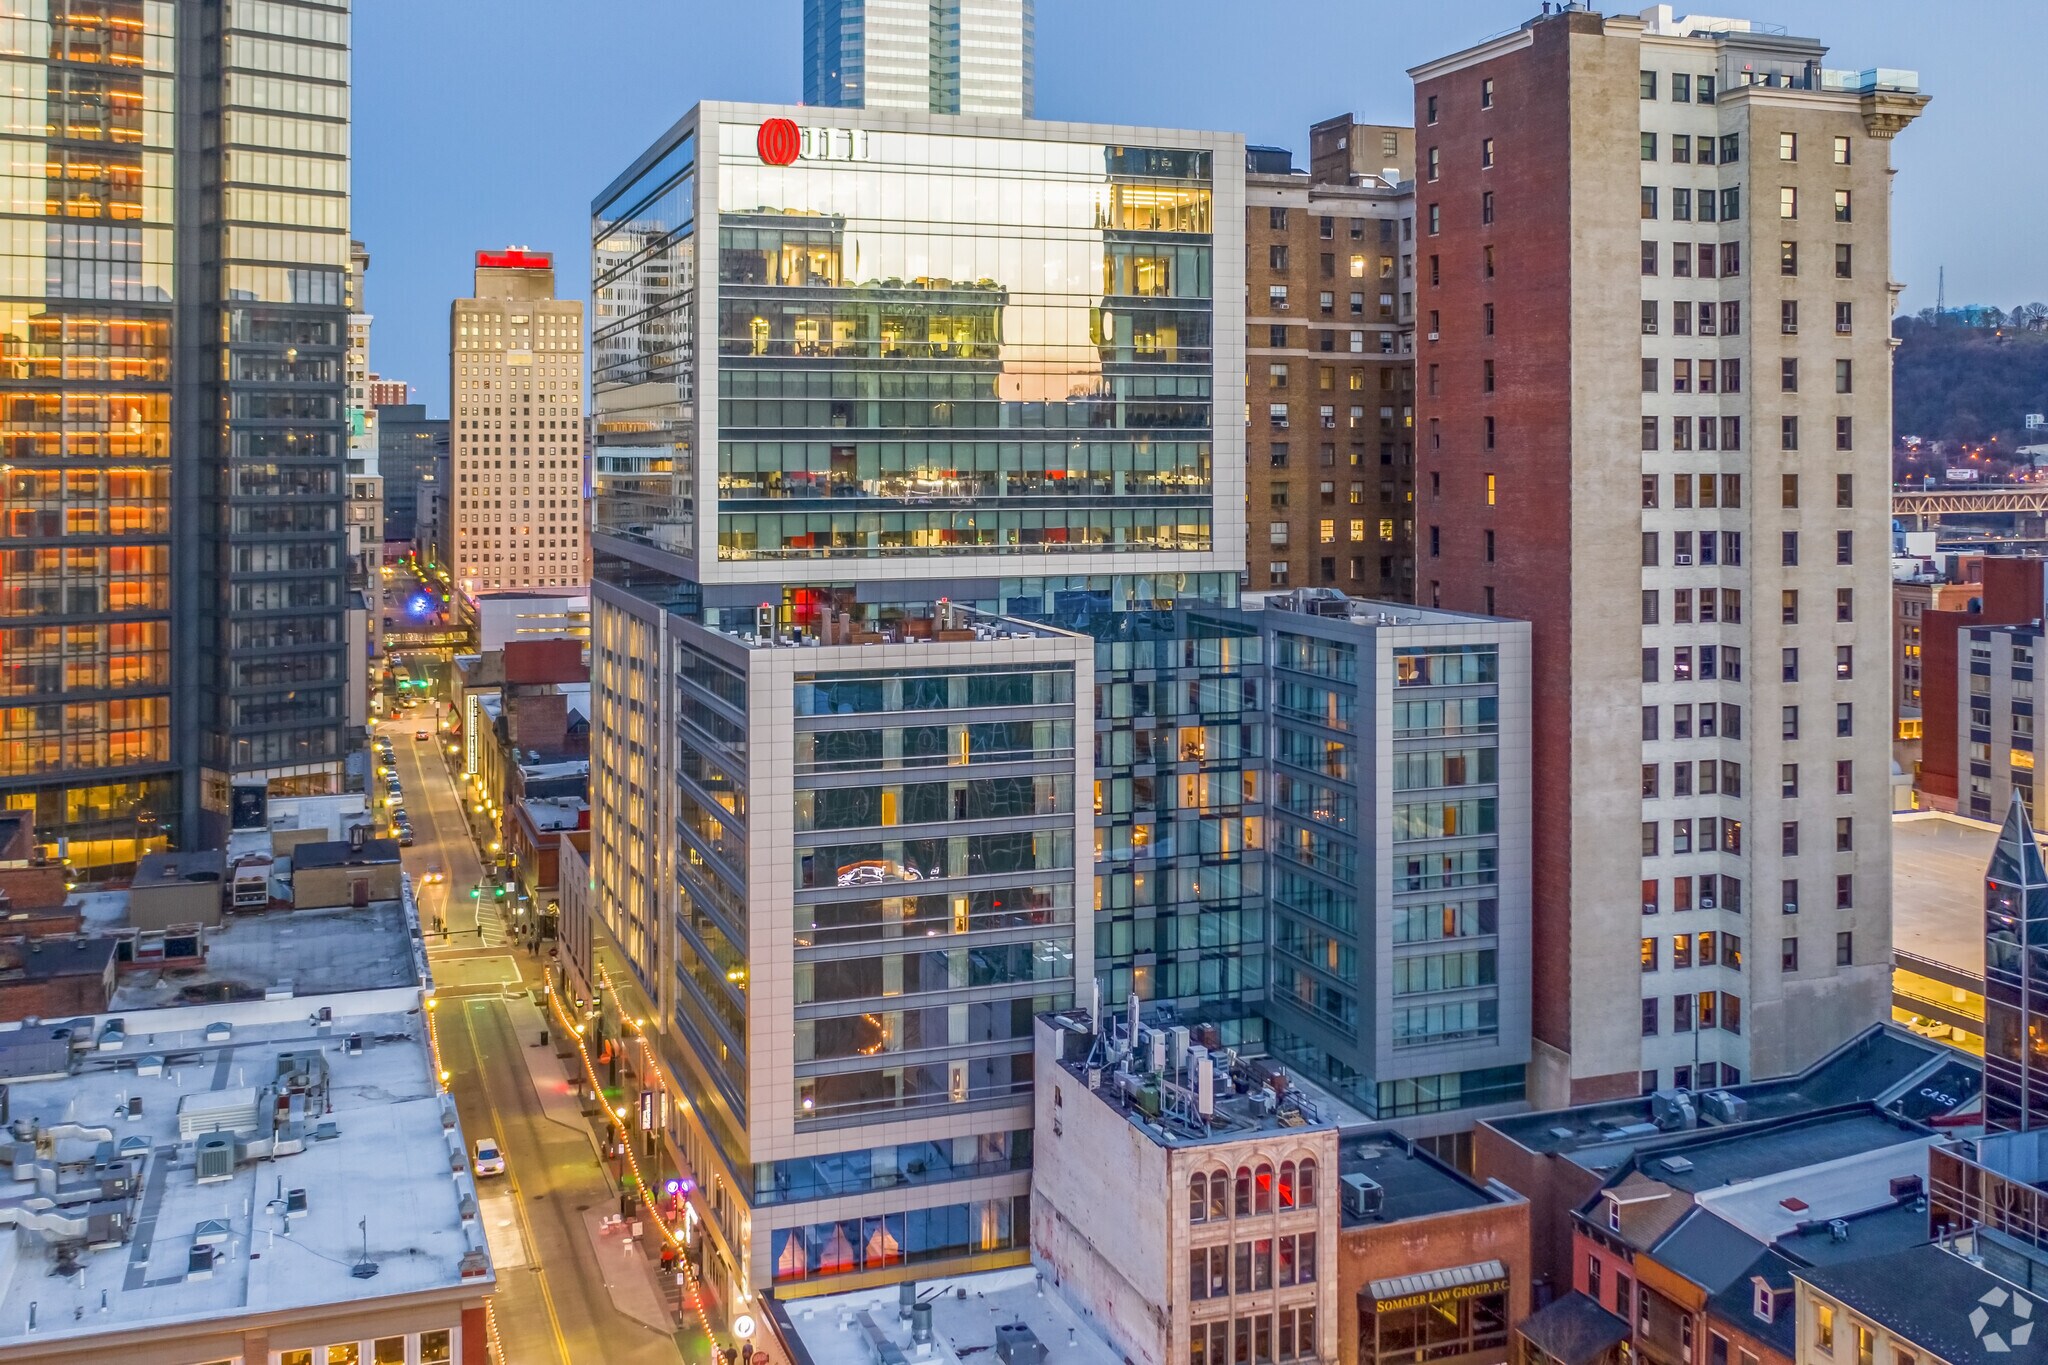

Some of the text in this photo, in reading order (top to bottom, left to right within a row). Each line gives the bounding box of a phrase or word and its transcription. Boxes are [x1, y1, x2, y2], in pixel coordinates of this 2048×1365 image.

[800, 126, 870, 161] JLL
[1920, 1088, 1957, 1106] CASS
[1376, 1294, 1427, 1313] SOMMER
[1428, 1290, 1451, 1303] LAW
